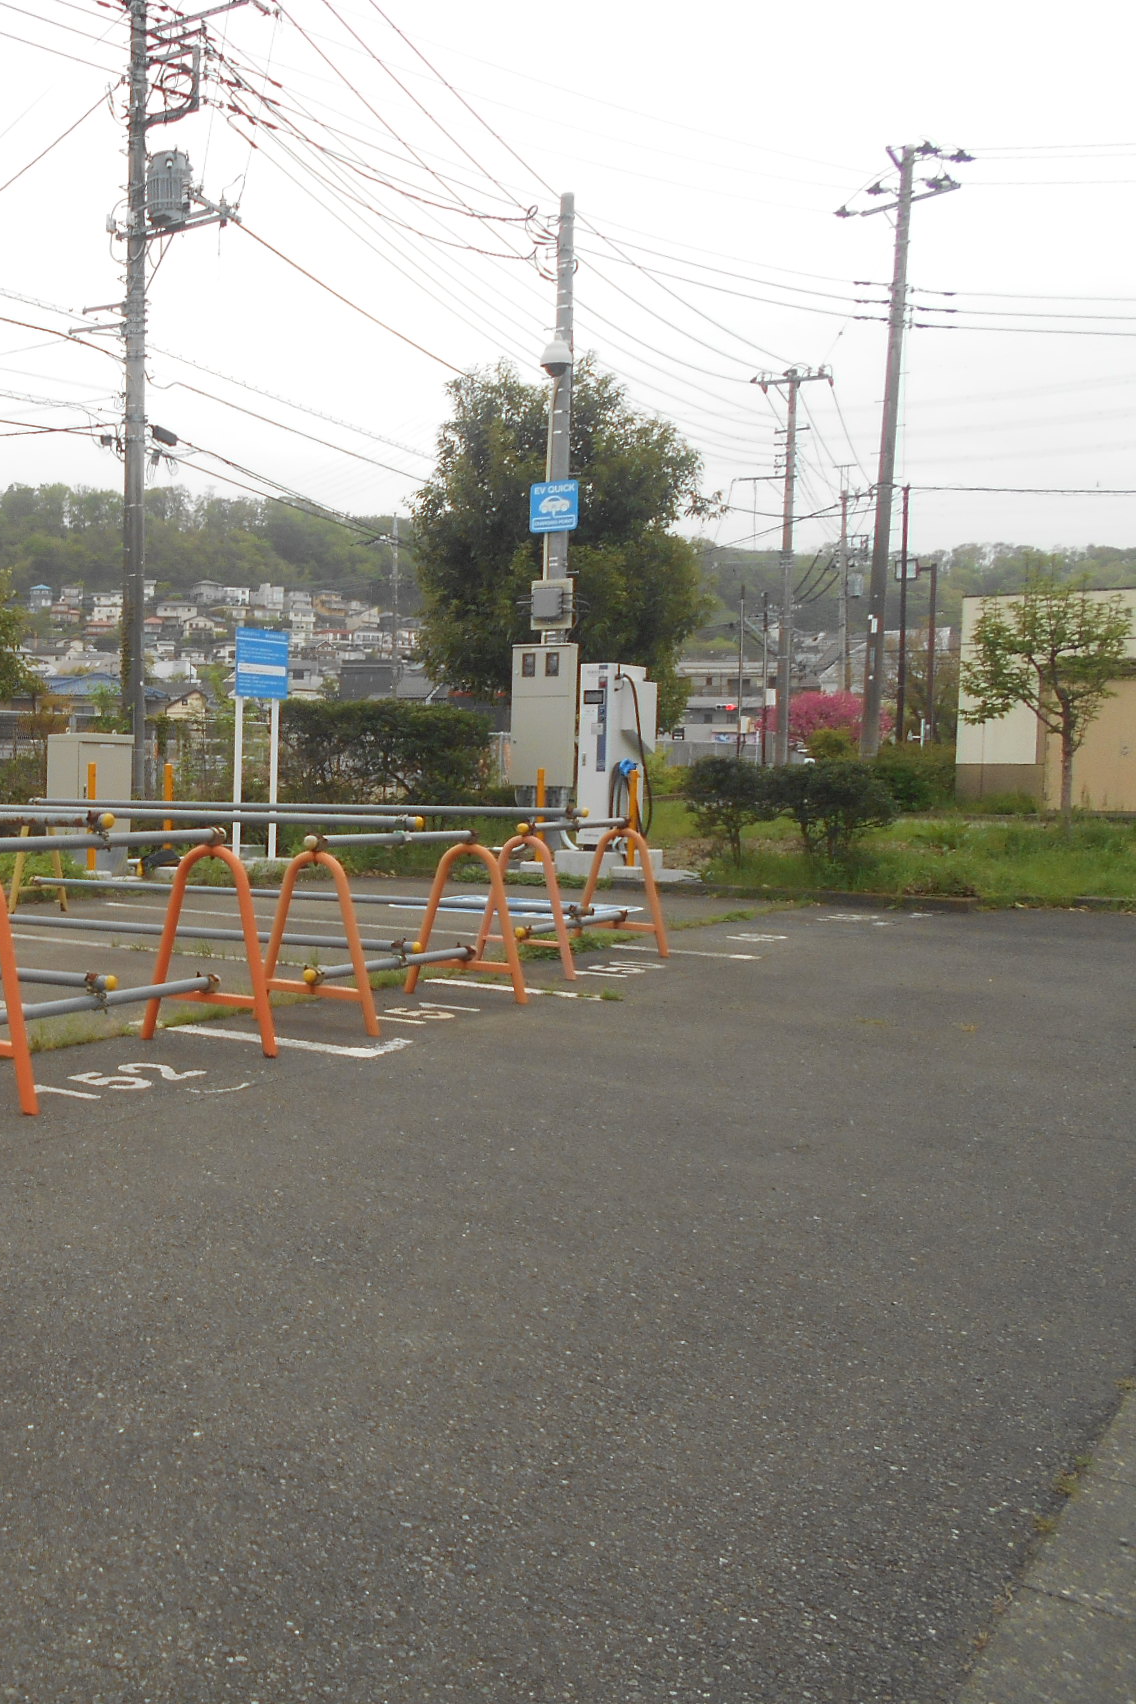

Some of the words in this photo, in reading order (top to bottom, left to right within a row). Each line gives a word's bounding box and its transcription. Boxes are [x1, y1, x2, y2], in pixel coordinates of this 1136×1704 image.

[534, 486, 546, 495] EV
[548, 483, 575, 493] QUICK
[574, 961, 665, 978] 150
[376, 1002, 481, 1024] 151
[33, 1062, 207, 1099] 152
